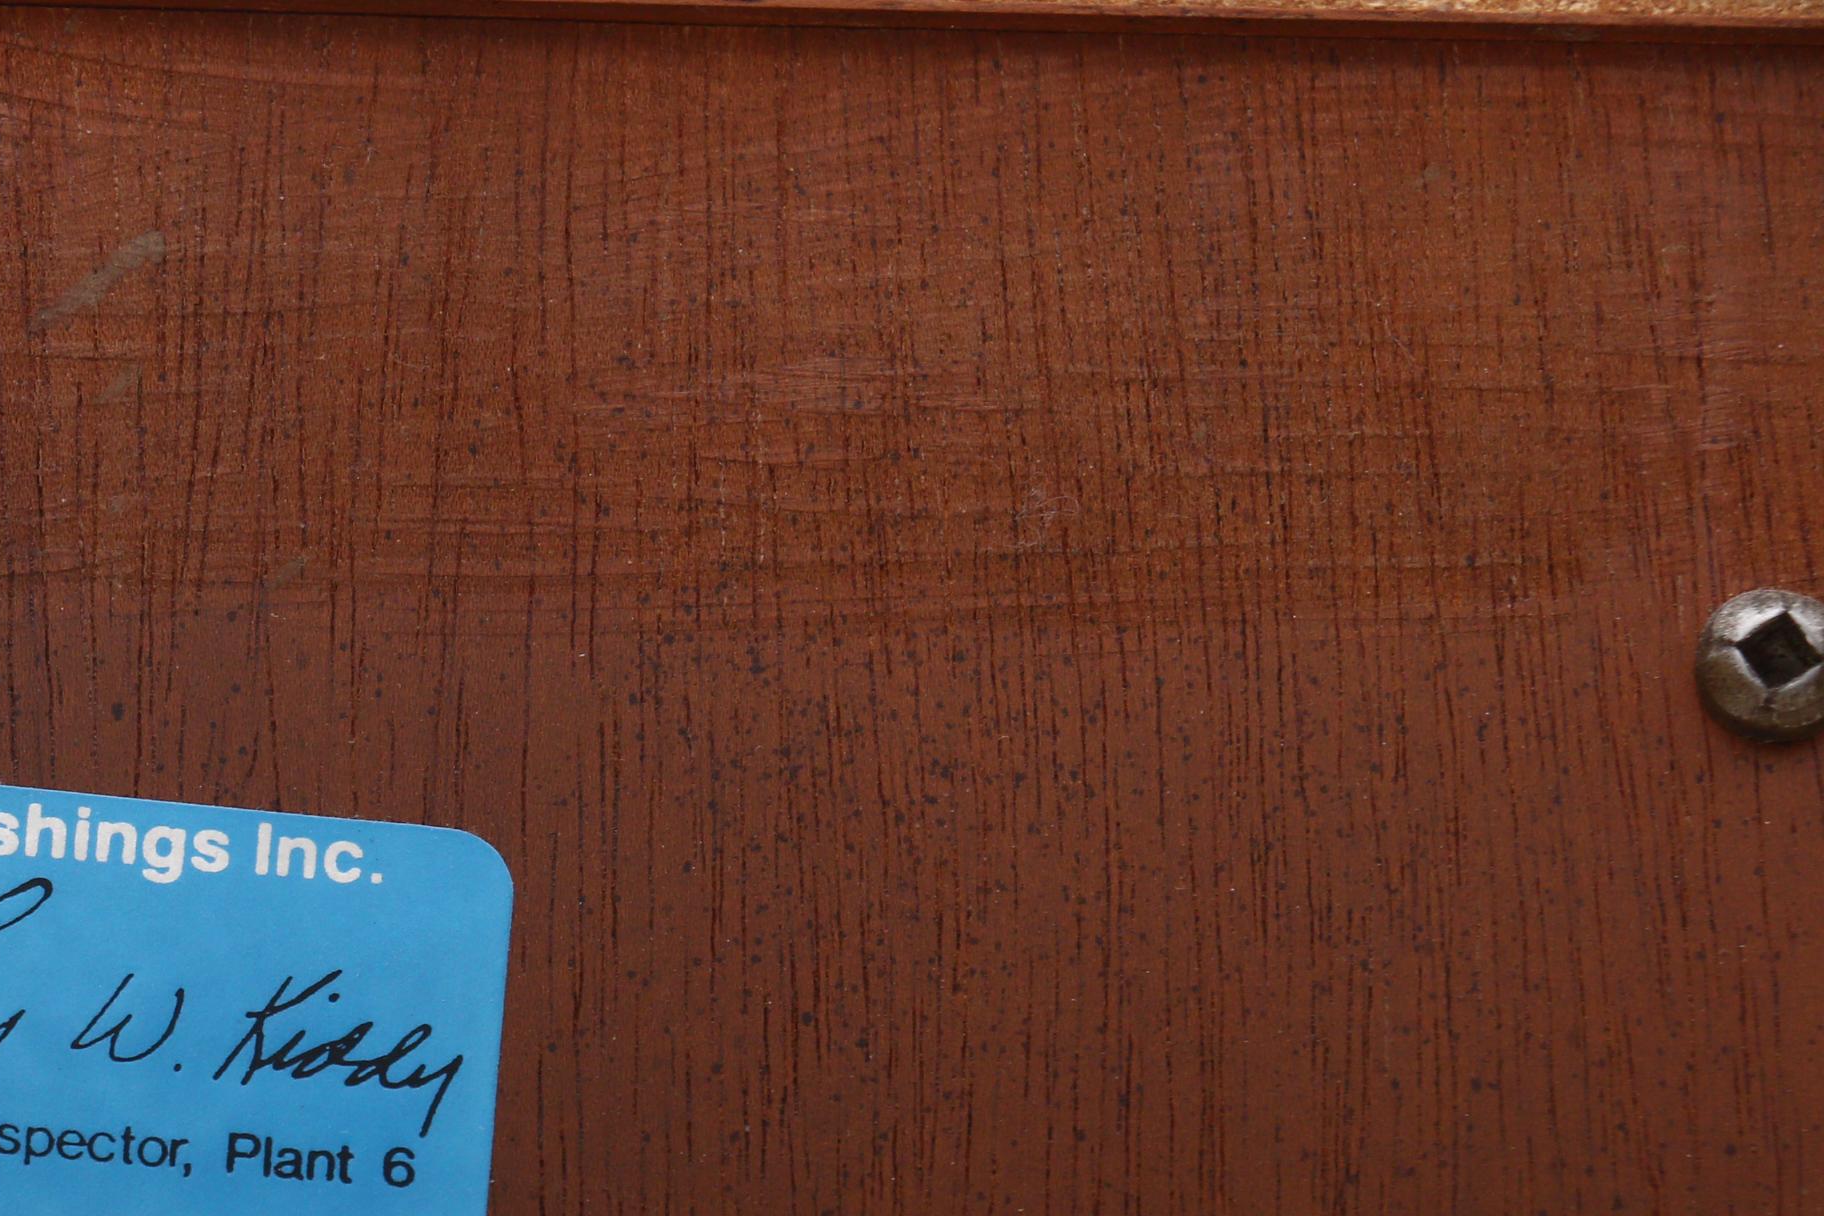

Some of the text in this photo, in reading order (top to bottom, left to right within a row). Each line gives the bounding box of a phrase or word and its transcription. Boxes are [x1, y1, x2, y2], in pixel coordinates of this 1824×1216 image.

[254, 821, 384, 885] Inc.
[69, 972, 186, 1074] W.
[225, 1131, 356, 1185] Plant
[381, 1145, 418, 1190] 6
